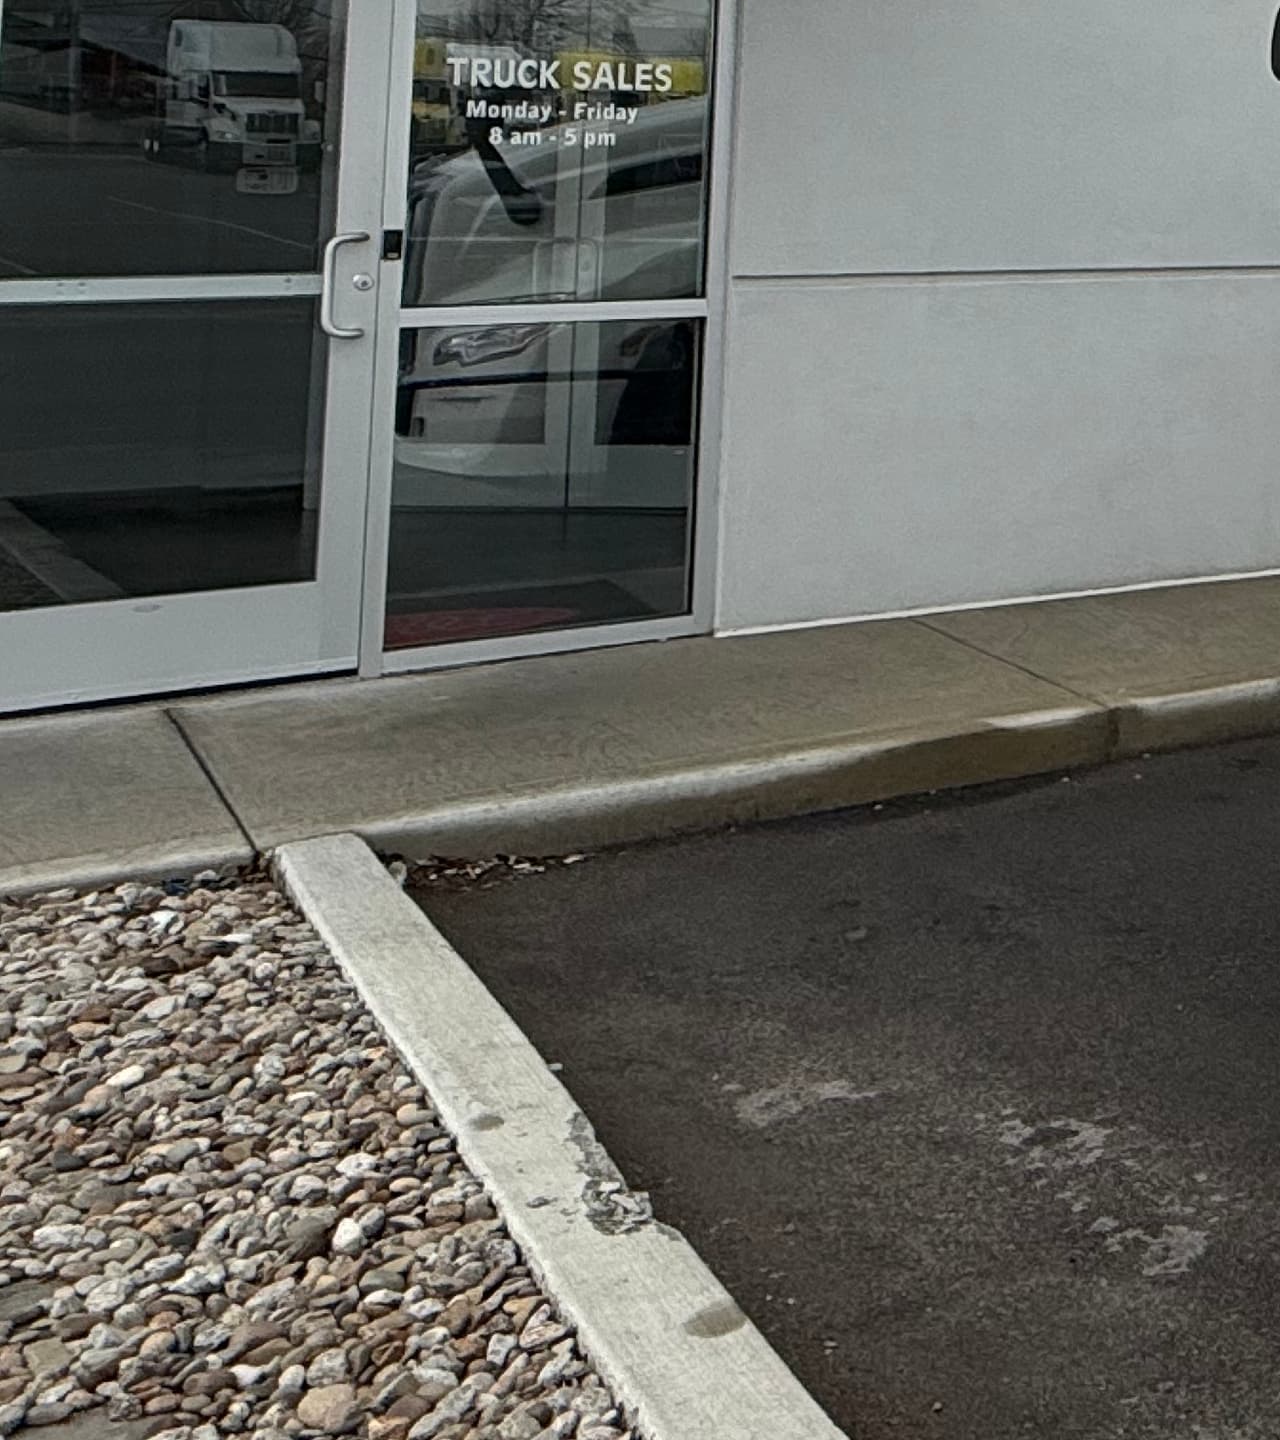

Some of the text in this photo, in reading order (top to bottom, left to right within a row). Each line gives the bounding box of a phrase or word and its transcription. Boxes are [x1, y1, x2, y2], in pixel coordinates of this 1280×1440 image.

[446, 57, 673, 92] TRUCK SALES
[465, 99, 552, 123] Monday
[573, 102, 638, 125] Friday
[488, 126, 504, 146] 8
[510, 130, 542, 146] am
[563, 127, 578, 146] 5
[583, 130, 617, 150] pm
